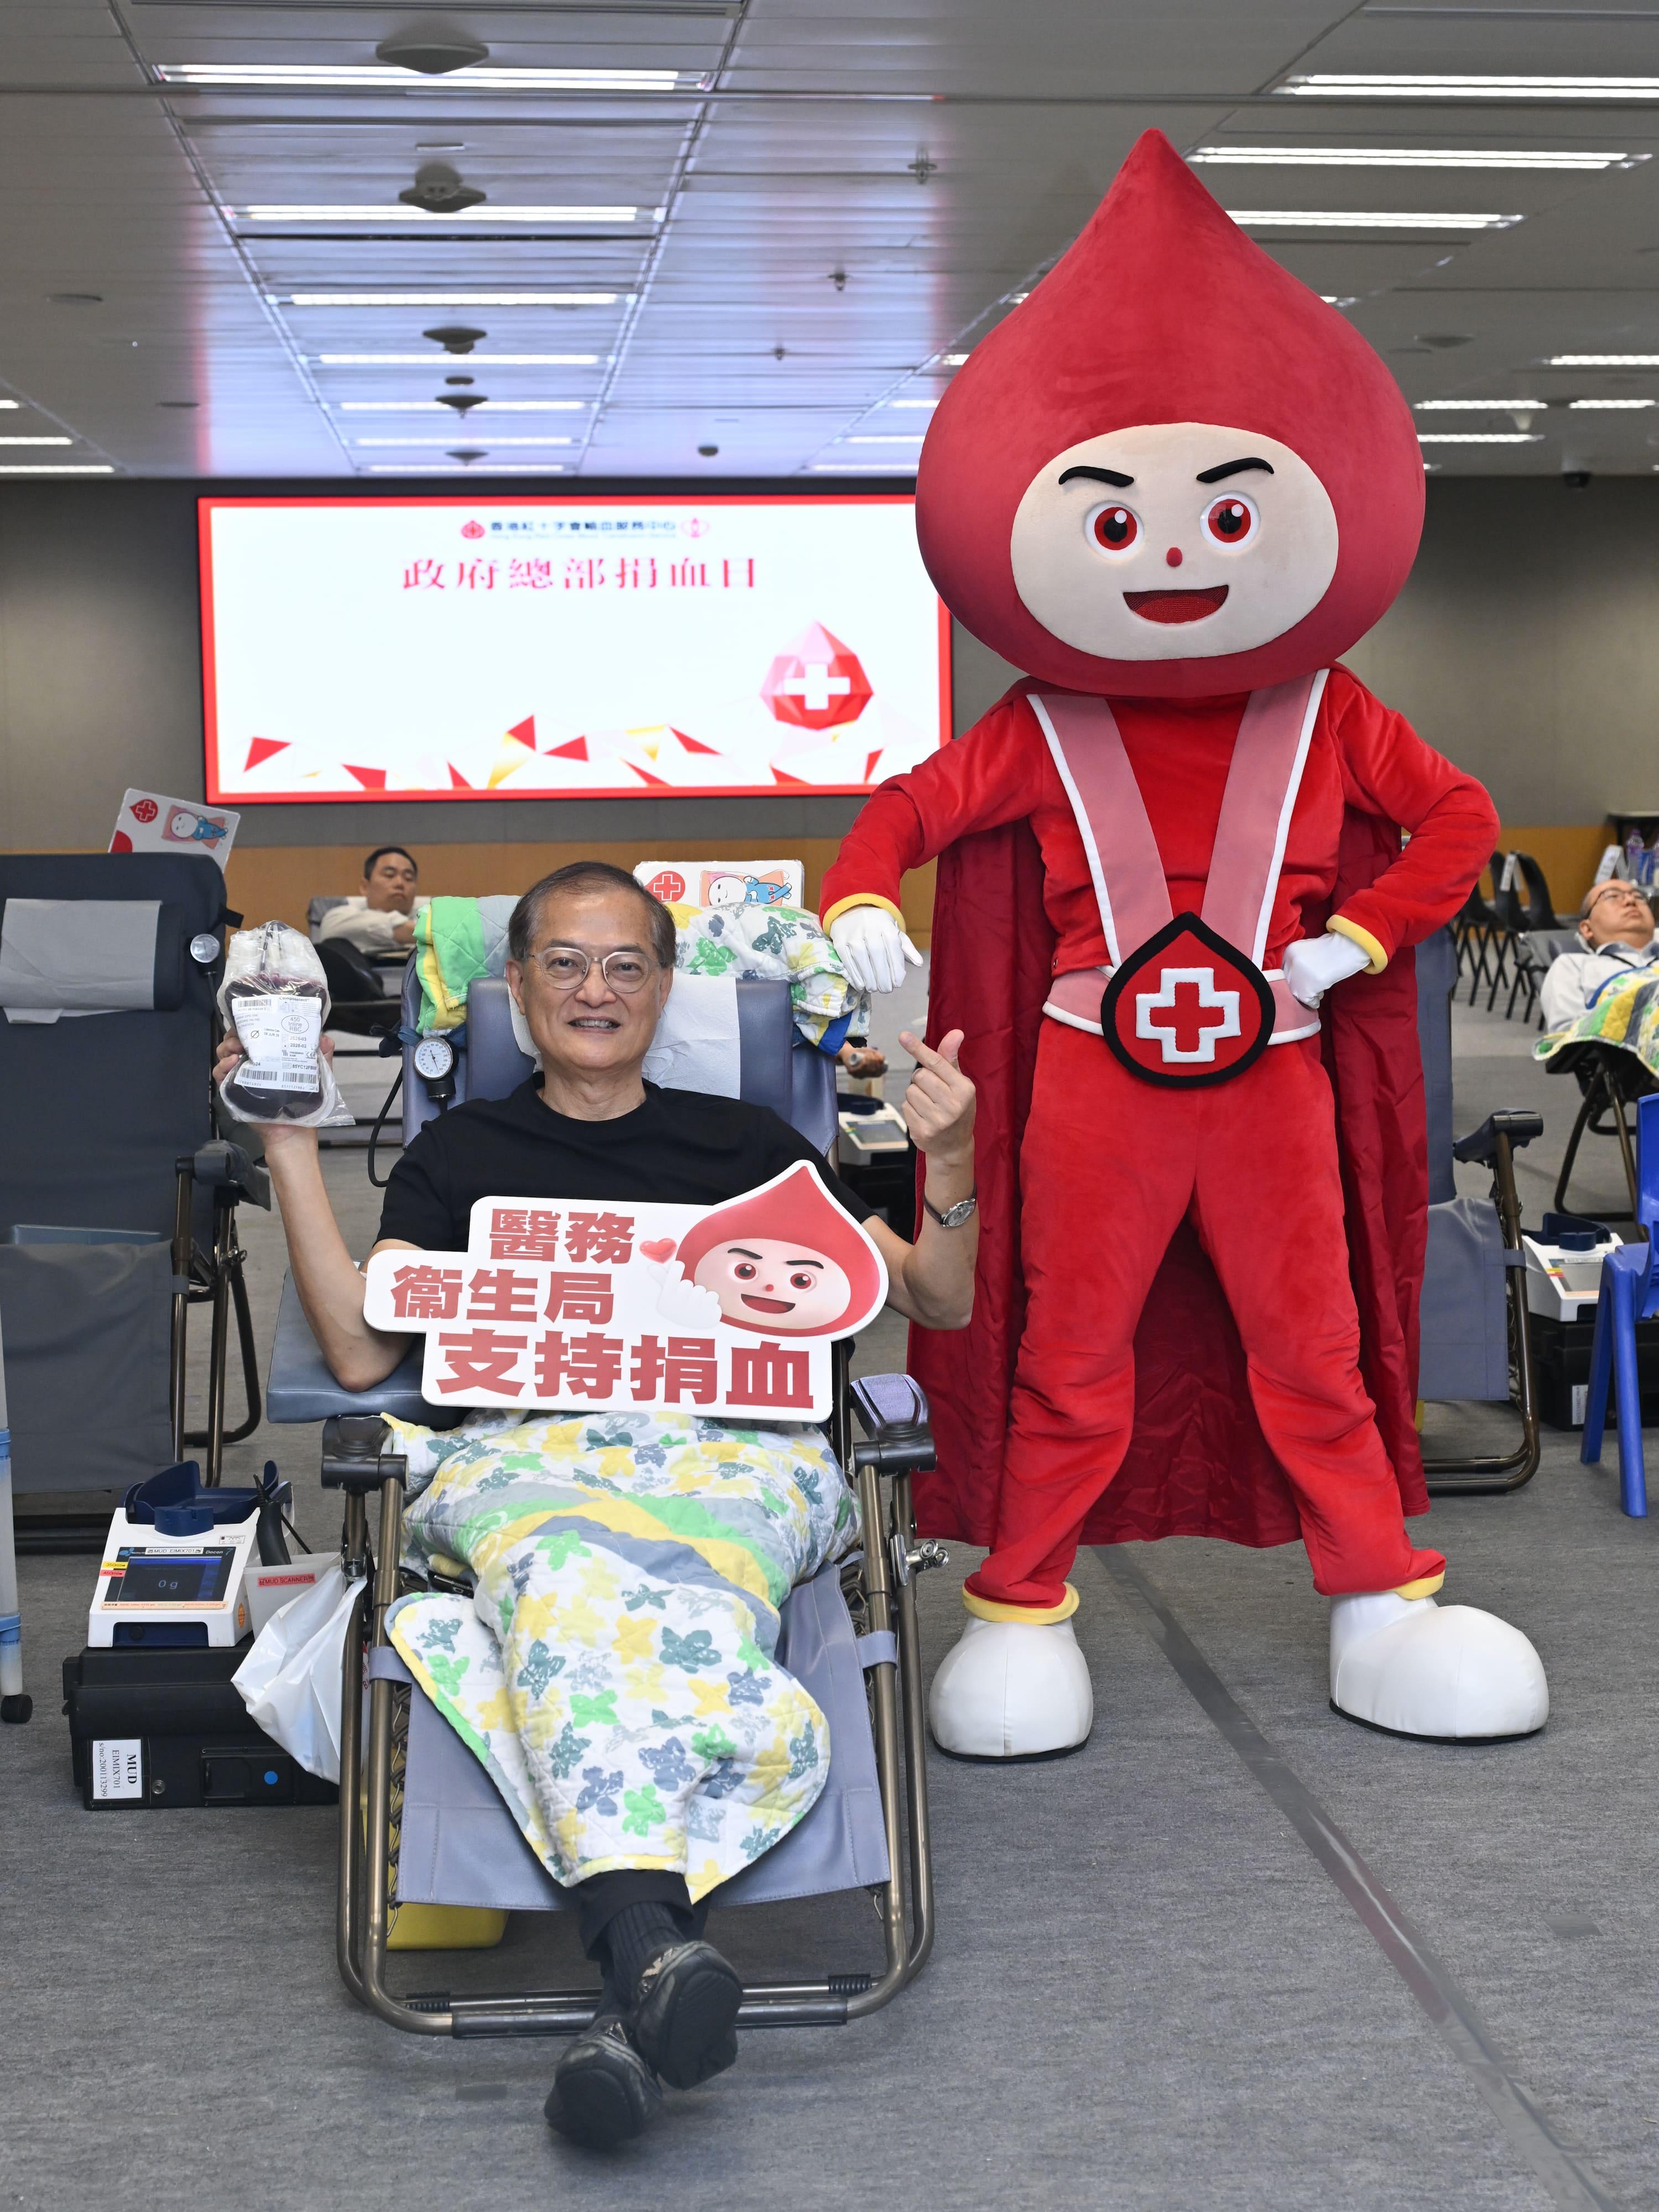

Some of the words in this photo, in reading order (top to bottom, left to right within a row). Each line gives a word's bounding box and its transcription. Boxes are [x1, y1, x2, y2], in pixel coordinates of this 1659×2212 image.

[403, 557, 754, 589] 政府總部捐血日
[490, 1209, 635, 1264] 醫務
[437, 1329, 814, 1408] 支持捐血
[169, 1580, 178, 1589] g
[98, 1743, 108, 1797] s/no:200113299
[112, 1750, 121, 1788] EIMIX701
[127, 1754, 137, 1784] MUD
